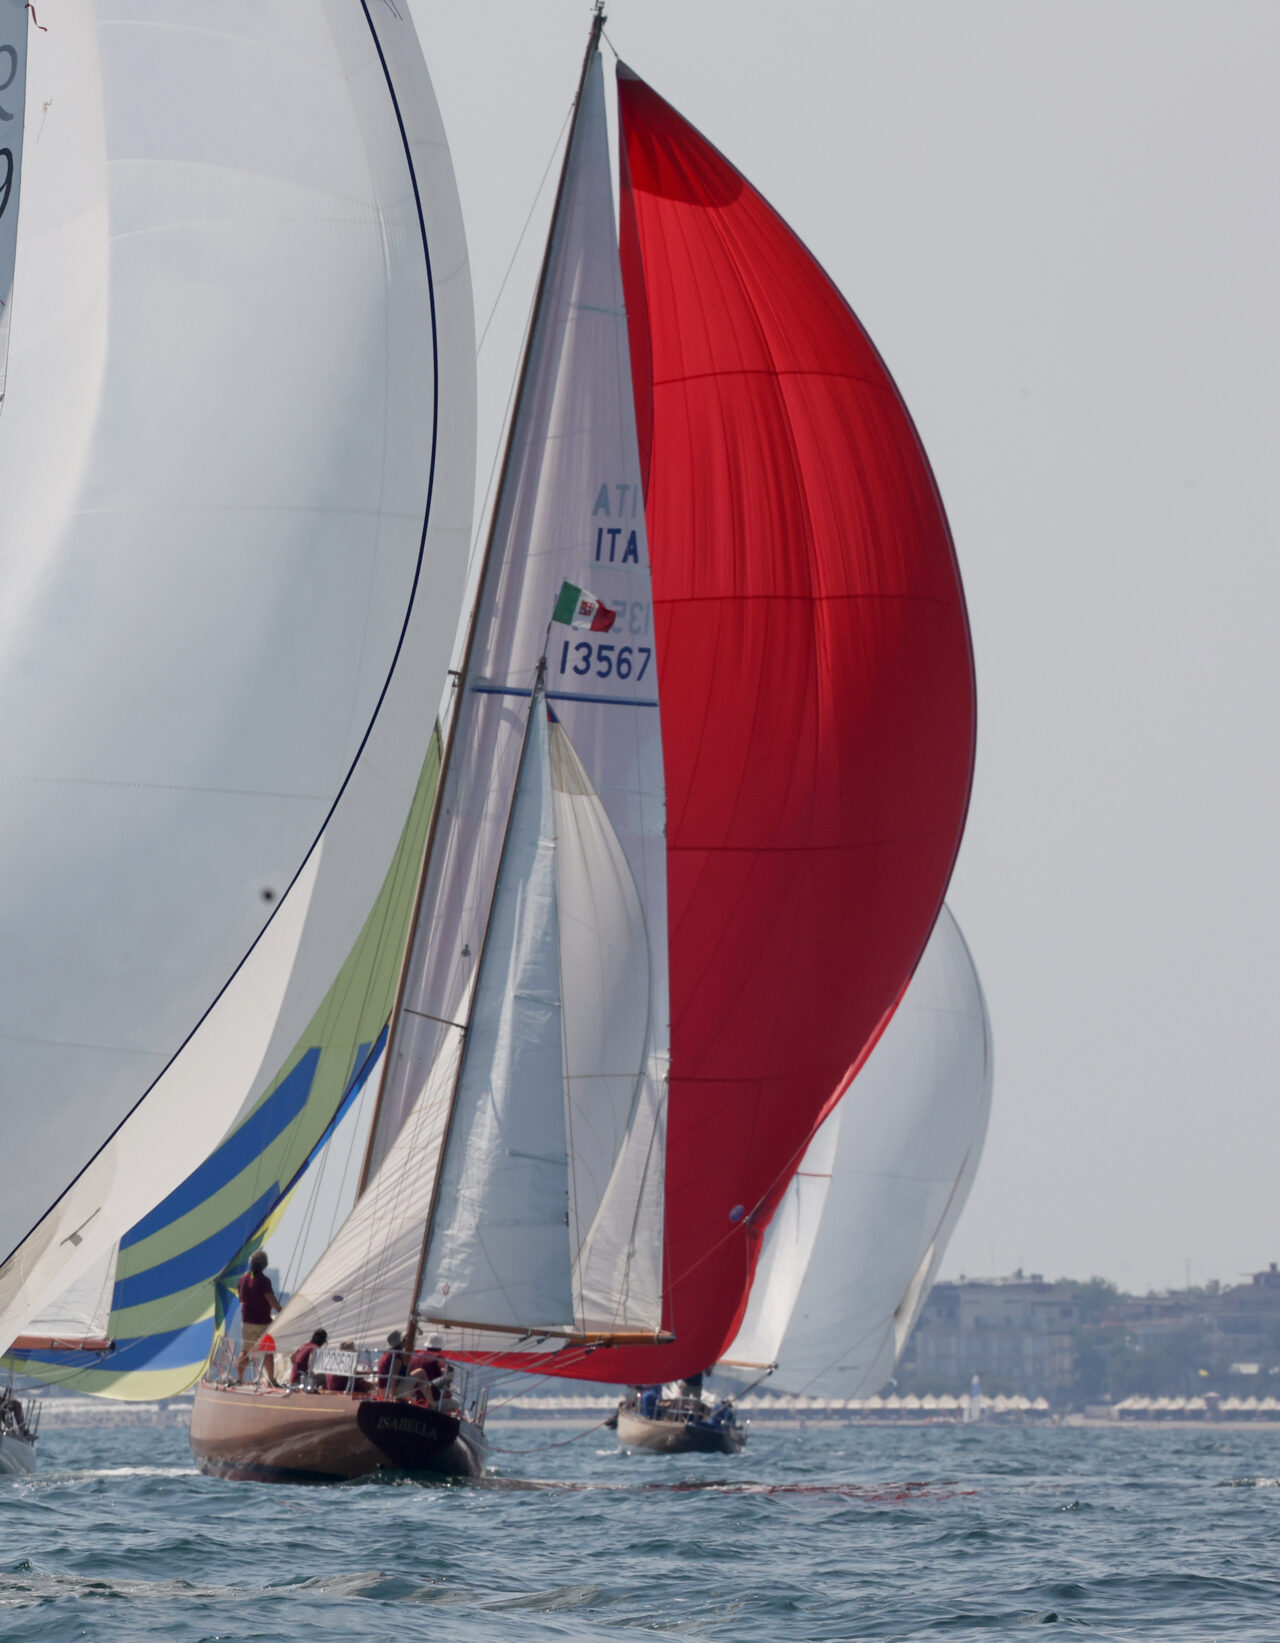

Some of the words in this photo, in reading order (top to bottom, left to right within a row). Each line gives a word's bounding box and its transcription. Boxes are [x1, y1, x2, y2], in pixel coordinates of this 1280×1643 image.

[595, 527, 639, 564] ITA
[560, 640, 651, 681] 13567
[376, 1415, 437, 1440] ISABELLA
